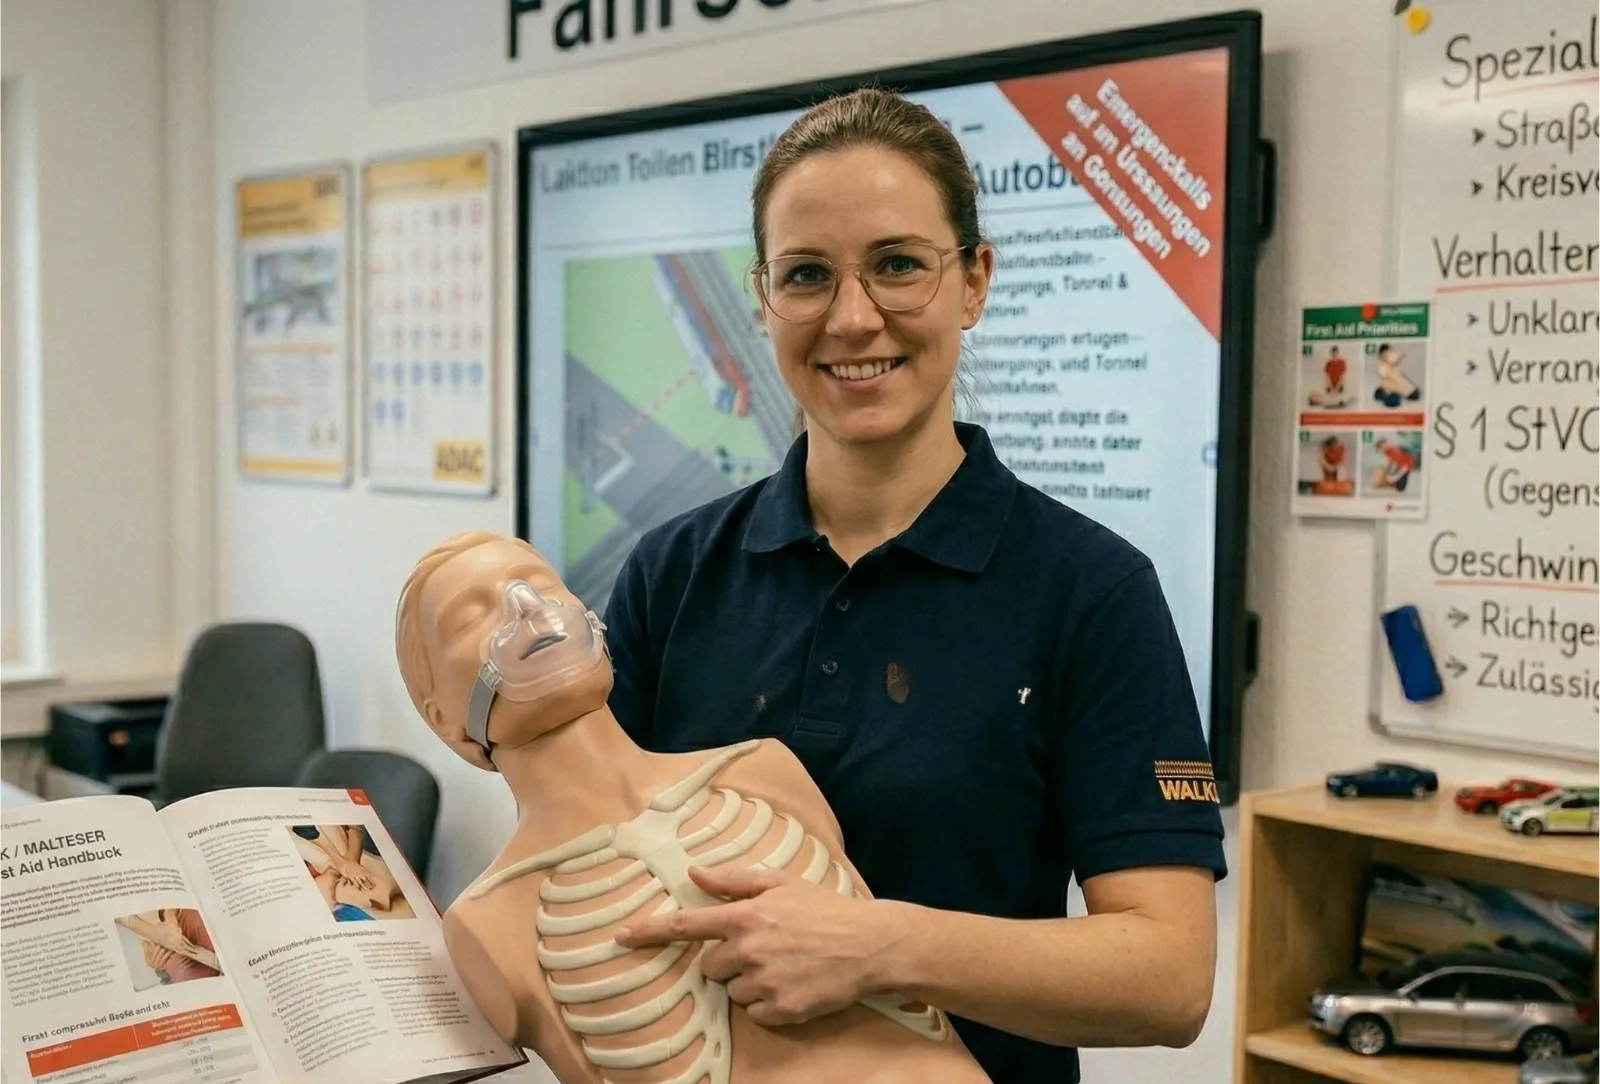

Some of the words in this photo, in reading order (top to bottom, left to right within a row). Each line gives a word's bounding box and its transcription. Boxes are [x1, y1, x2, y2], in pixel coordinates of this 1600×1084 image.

[1442, 14, 1599, 103] Spezial
[974, 155, 1079, 195] Autob
[1496, 162, 1599, 201] Kreisv
[1335, 322, 1356, 337] Aid
[1488, 299, 1599, 336] Unklar
[1487, 347, 1599, 394] Verran
[1470, 406, 1487, 452] 1
[1430, 530, 1599, 584] Geschwin
[1481, 600, 1599, 659] Richtge
[19, 859, 45, 876] Aid
[47, 845, 123, 870] Handbuck
[23, 829, 106, 856] MALTESER
